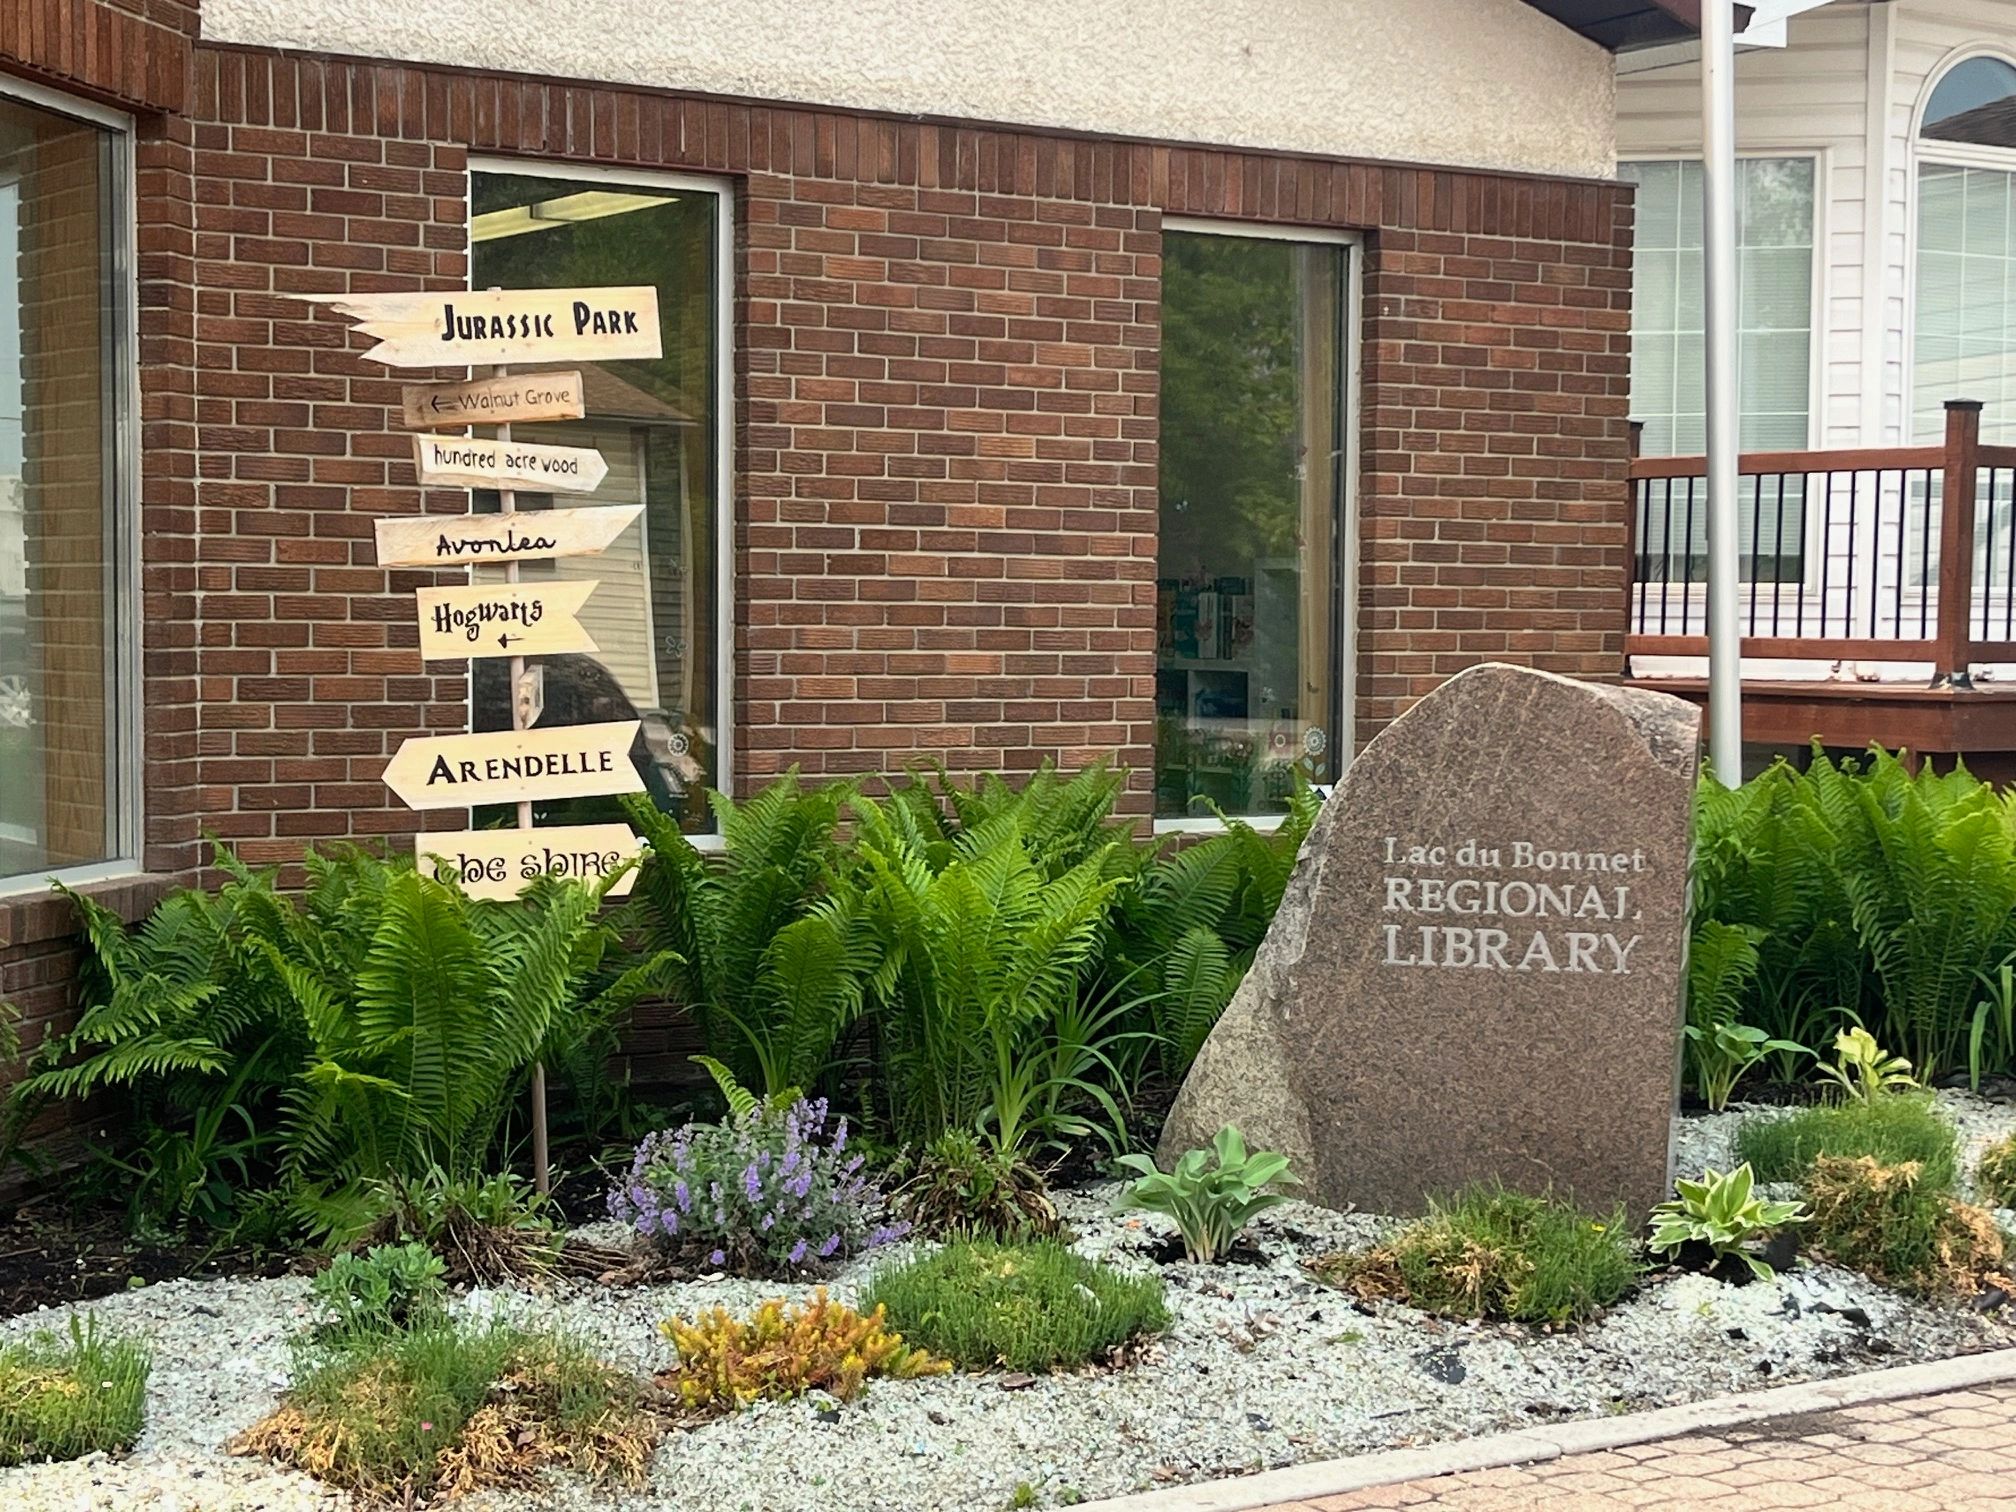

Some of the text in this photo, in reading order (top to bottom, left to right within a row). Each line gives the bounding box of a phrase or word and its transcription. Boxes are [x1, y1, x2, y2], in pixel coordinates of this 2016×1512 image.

[458, 387, 571, 409] Walnut Grove
[433, 443, 496, 470] hundred
[504, 452, 536, 471] acre
[435, 530, 557, 557] Avonlea
[431, 599, 543, 642] Hogwarts
[425, 750, 615, 786] ARENDELLE
[1383, 836, 1646, 873] Lac du Bonnet
[1381, 877, 1643, 920] REGIONAL
[1381, 924, 1643, 975] LIBRARY
